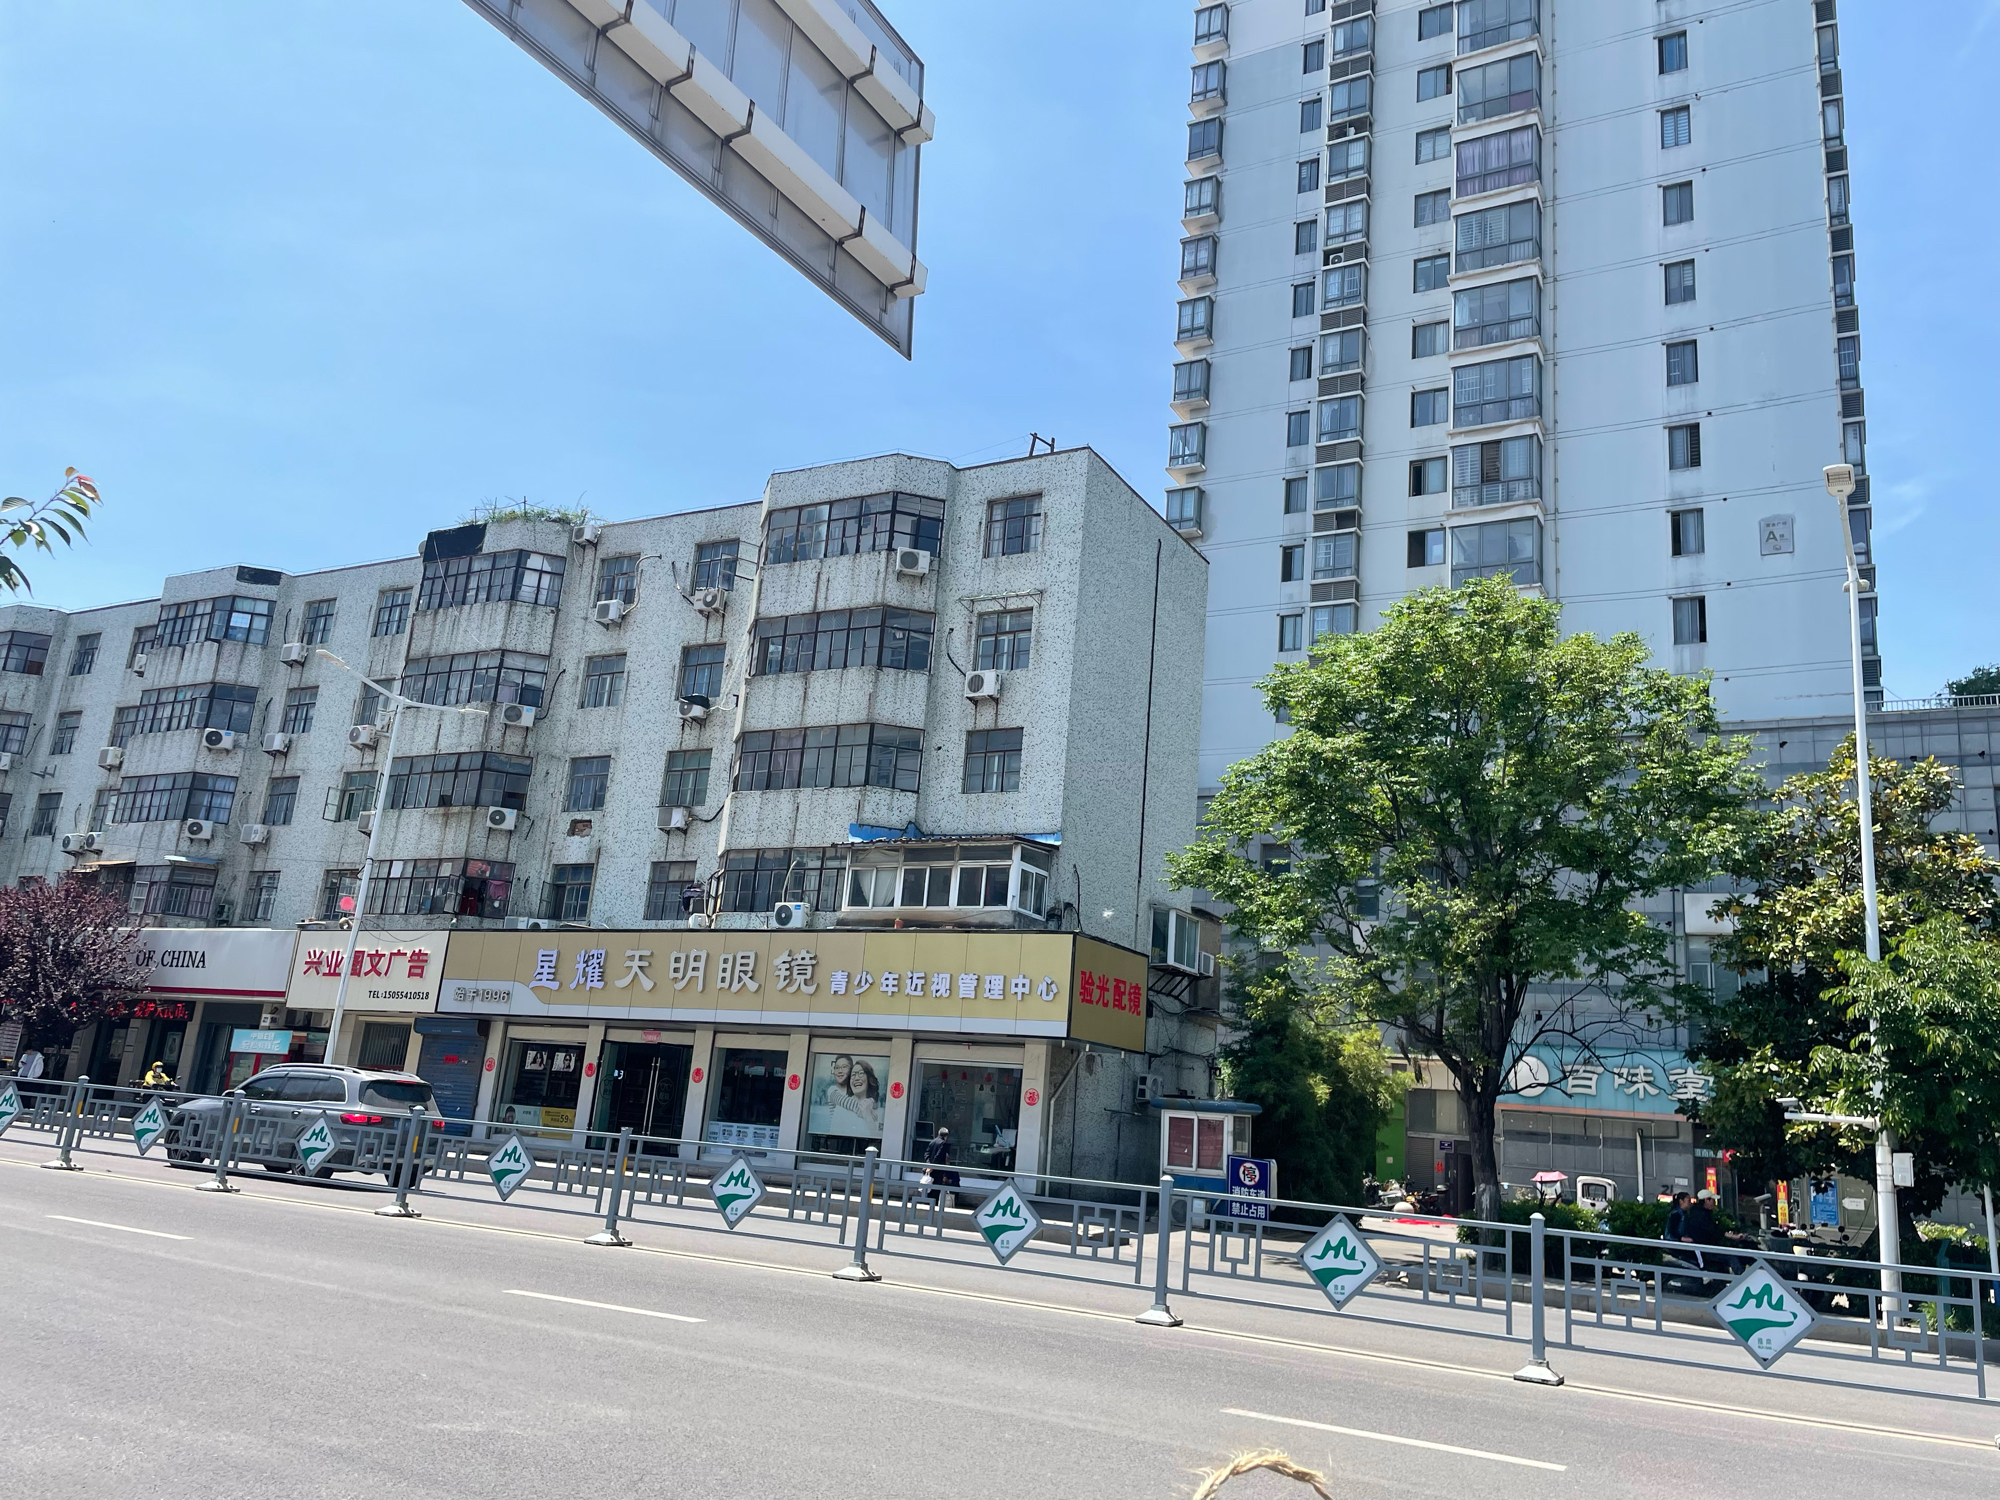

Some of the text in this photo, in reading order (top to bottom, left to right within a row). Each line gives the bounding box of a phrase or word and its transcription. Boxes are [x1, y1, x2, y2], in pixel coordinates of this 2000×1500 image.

[135, 949, 206, 968] OF CHINA
[303, 949, 429, 979] 兴业图文广告
[529, 948, 818, 995] 星耀天明眼镜
[453, 987, 511, 1003] 始于1996
[829, 970, 1059, 1002] 青少年近视管理中心
[1079, 970, 1142, 1017] 验光配镜
[1562, 1064, 1714, 1101] 百味堂
[1232, 1185, 1266, 1198] 消防车道
[1231, 1202, 1266, 1218] 禁止占用
